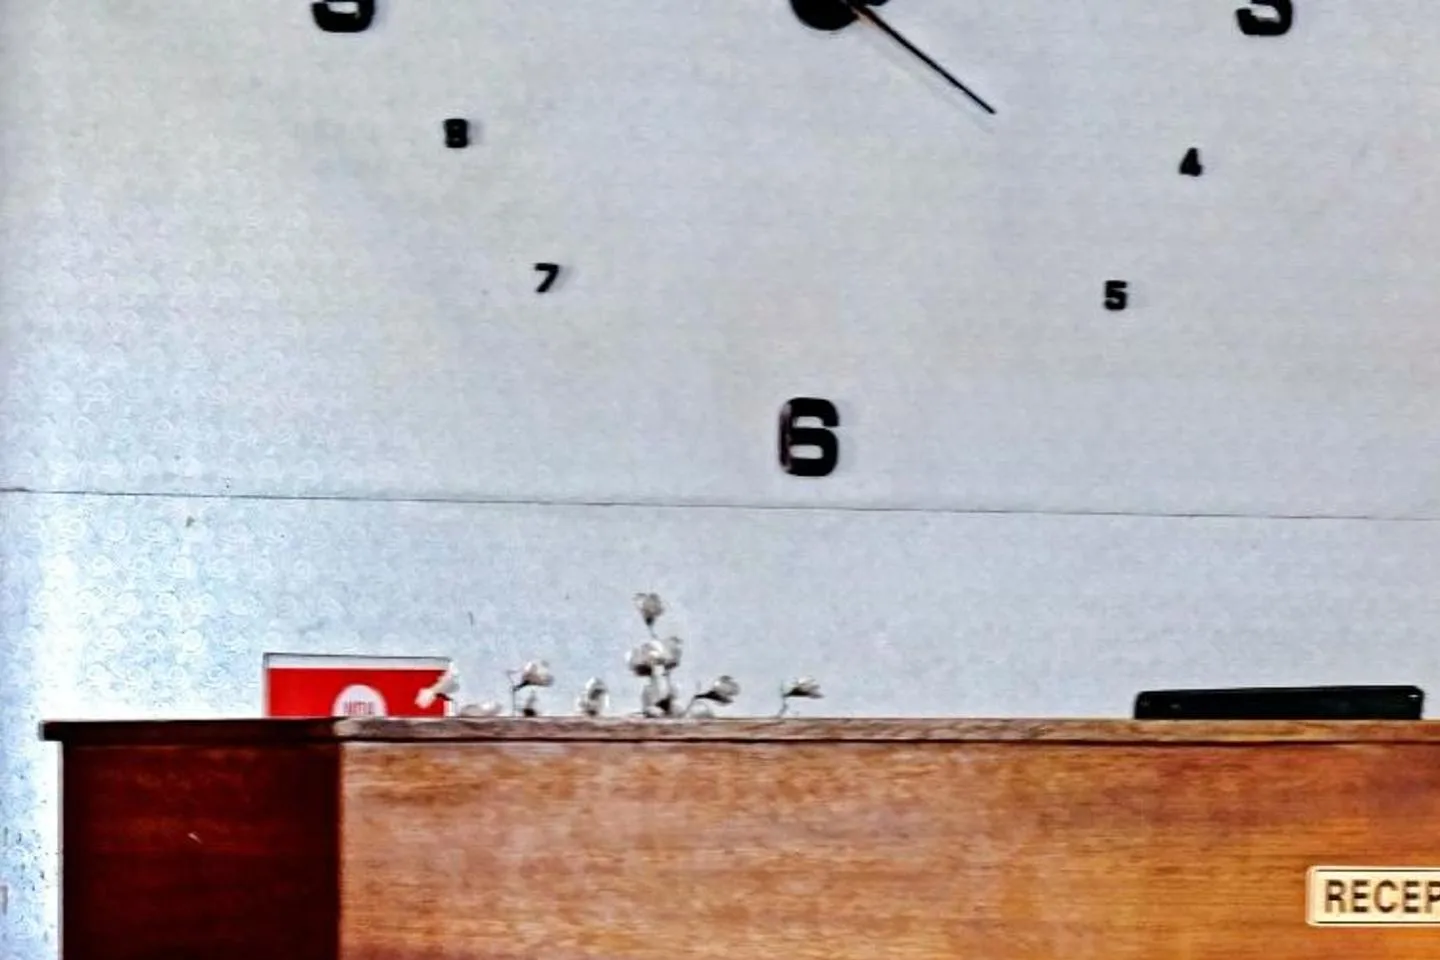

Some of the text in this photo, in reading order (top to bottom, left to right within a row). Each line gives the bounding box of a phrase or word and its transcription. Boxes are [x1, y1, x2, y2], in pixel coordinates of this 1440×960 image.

[443, 118, 471, 149] 8
[1178, 147, 1204, 177] 4
[534, 262, 561, 293] 7
[1103, 280, 1128, 311] 5
[777, 397, 841, 478] 6
